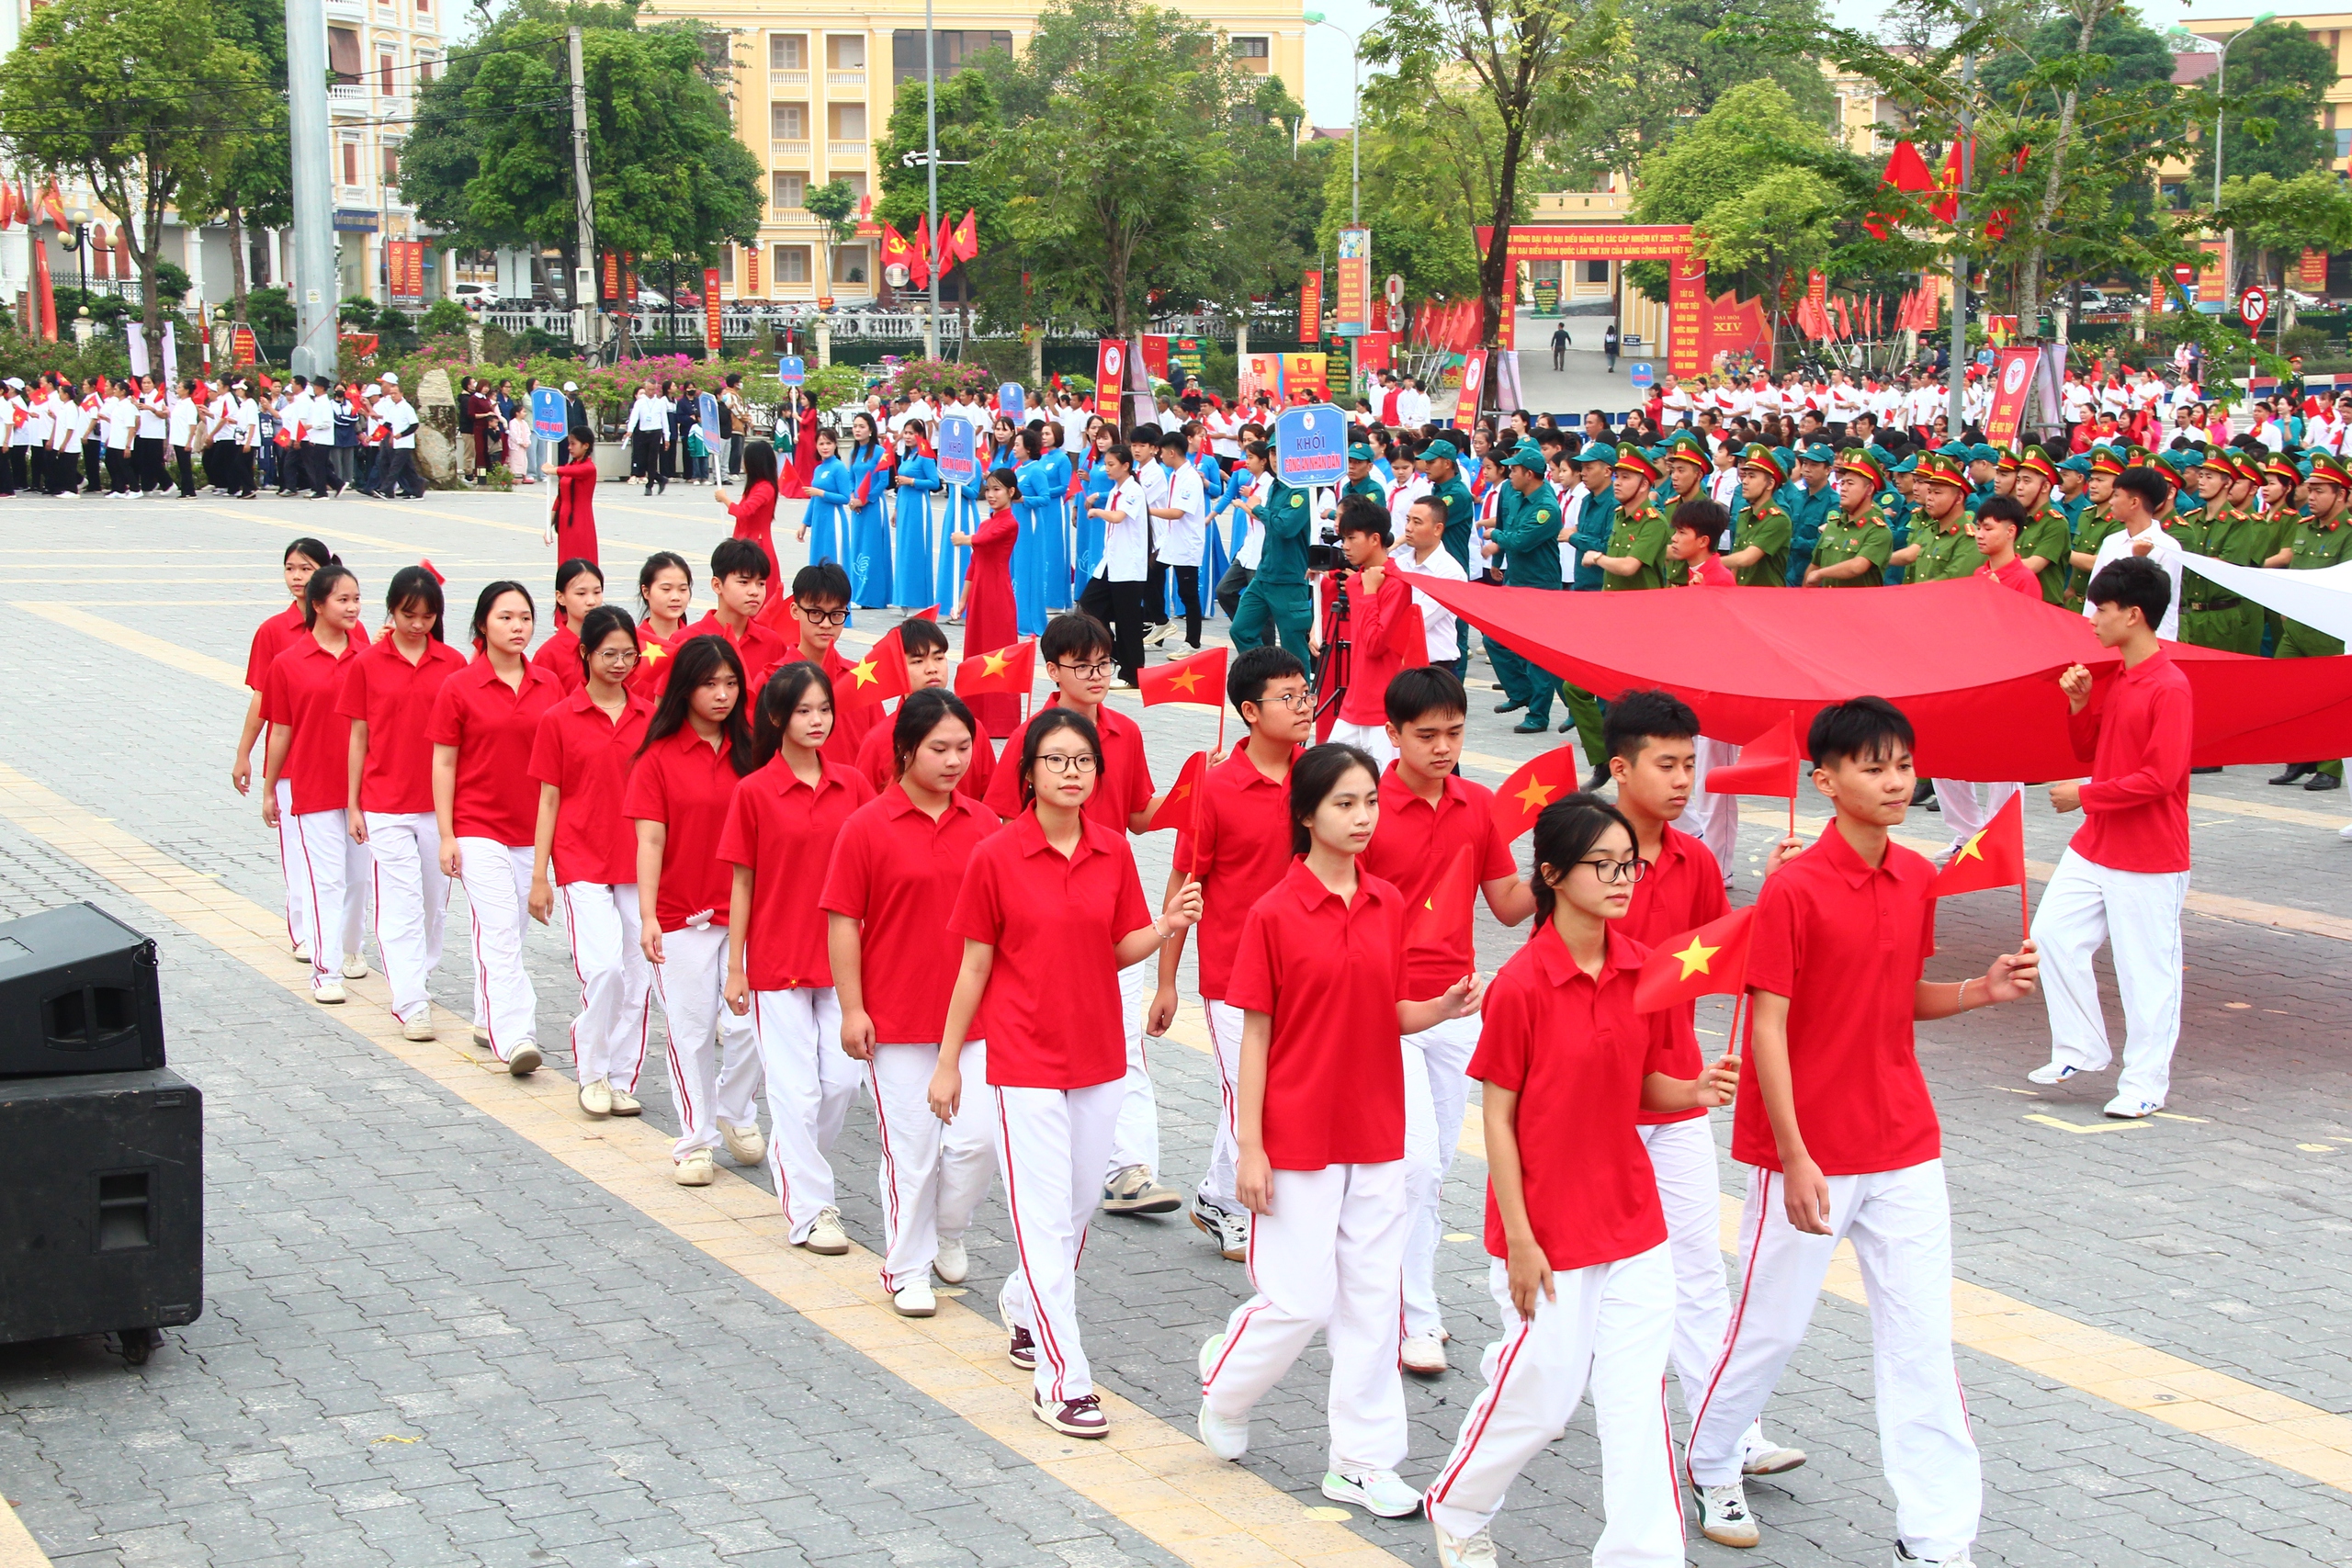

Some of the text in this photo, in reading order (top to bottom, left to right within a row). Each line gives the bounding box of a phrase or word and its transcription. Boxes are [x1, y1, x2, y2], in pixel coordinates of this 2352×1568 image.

[1605, 233, 1617, 243] CÁC
[1659, 234, 1674, 243] 2025
[1713, 322, 1743, 332] XIV
[948, 437, 964, 454] KHỐI
[1296, 430, 1326, 451] KHỐI
[942, 455, 972, 473] DÂN QUÂN
[1284, 450, 1340, 473] CÔNG AN NHÂN DÂN
